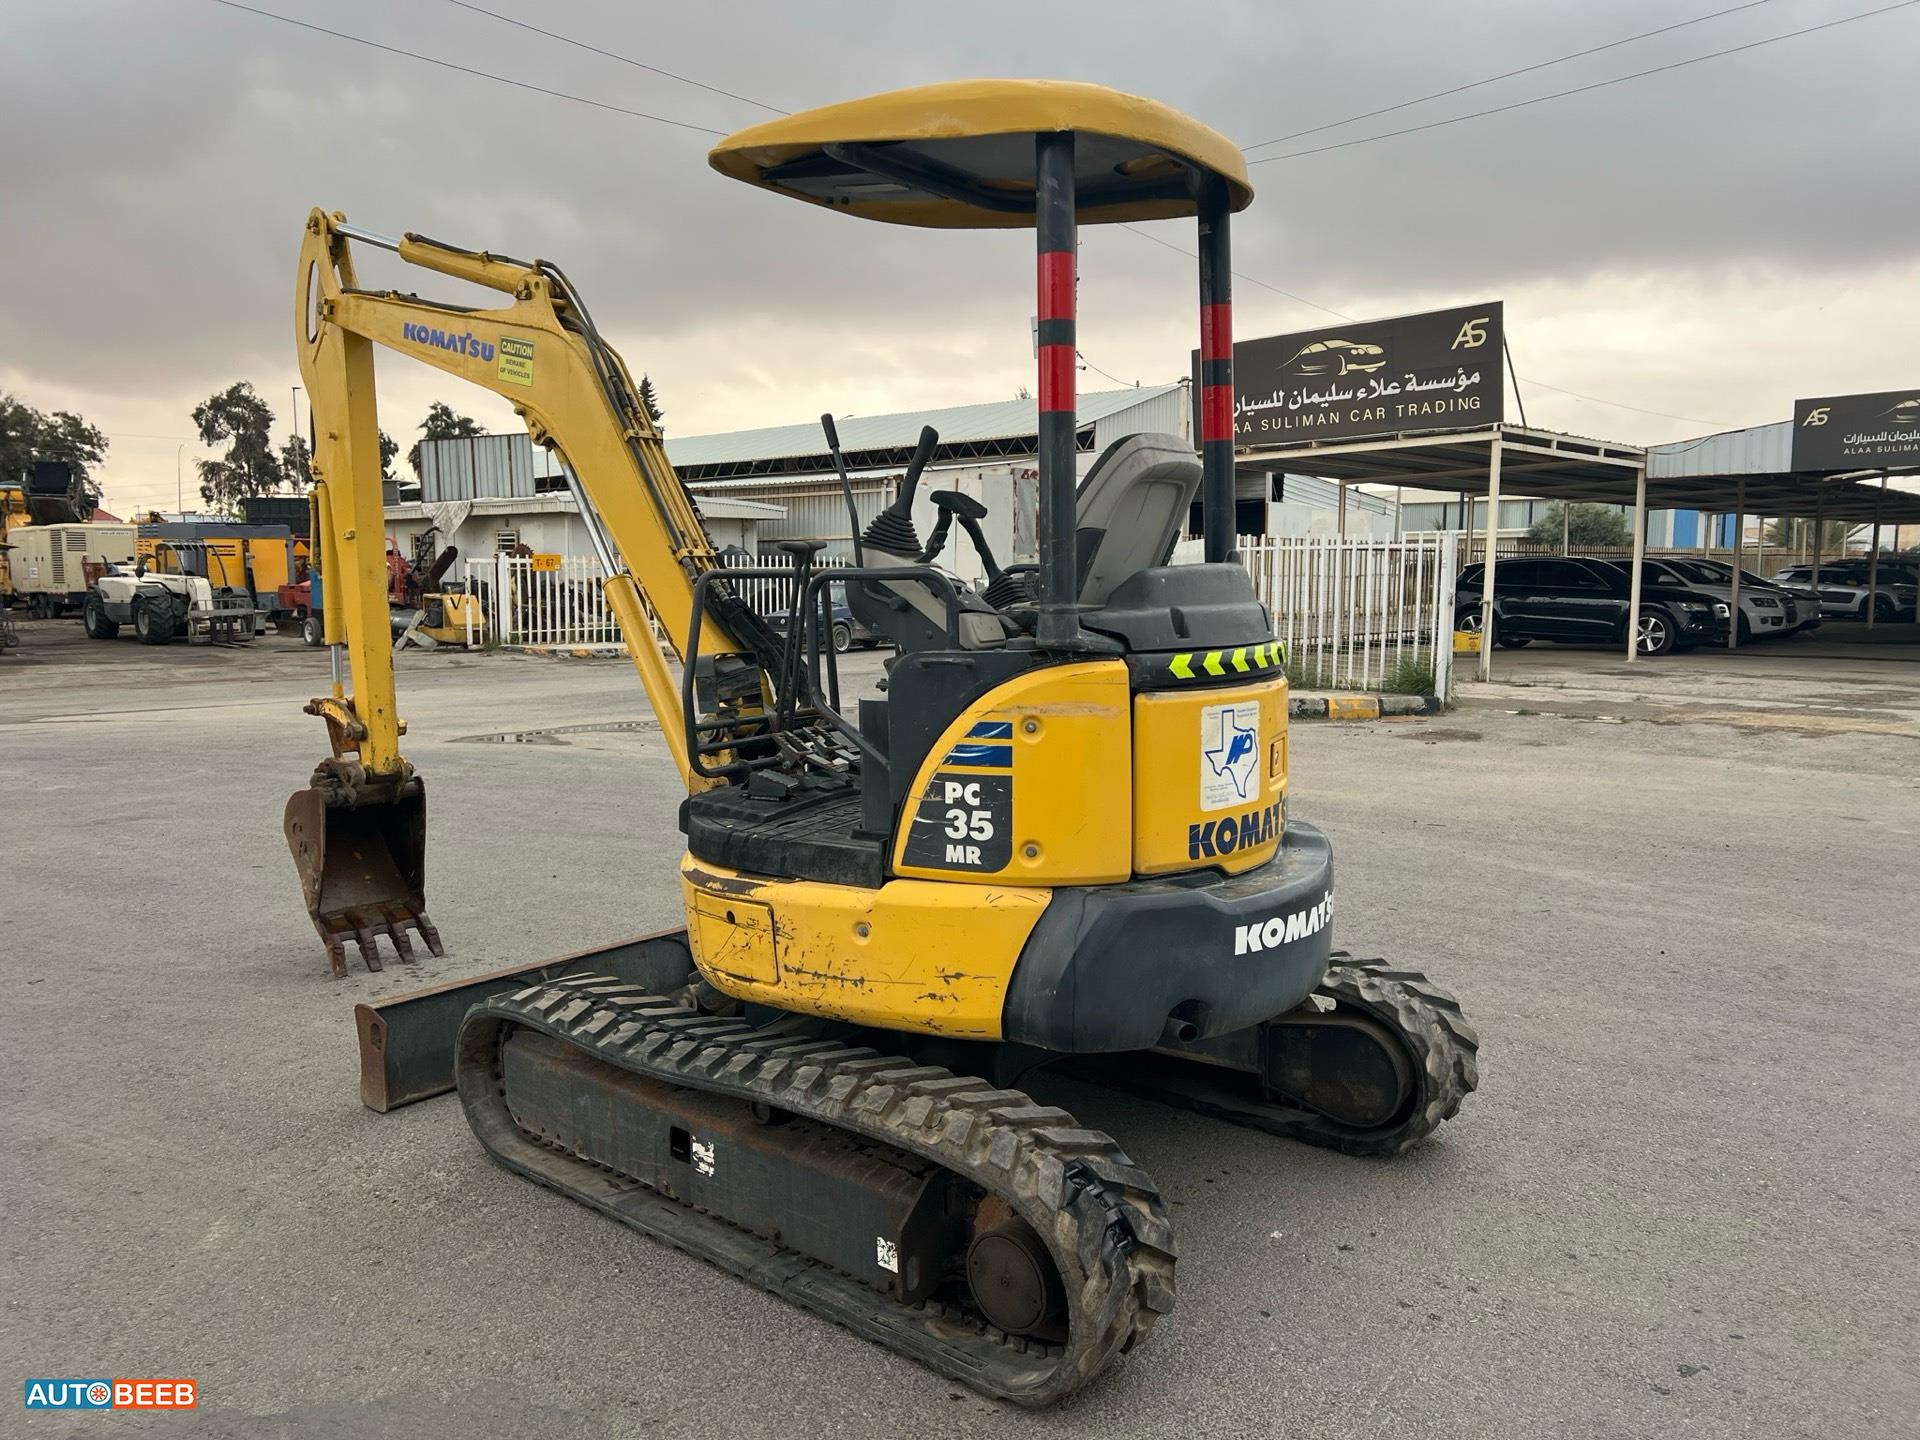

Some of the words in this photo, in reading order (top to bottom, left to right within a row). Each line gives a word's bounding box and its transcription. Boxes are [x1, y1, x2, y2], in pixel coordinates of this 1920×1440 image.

[403, 322, 494, 362] KOMATSU
[501, 341, 533, 358] CAUTION
[505, 359, 526, 368] BEWARE
[1356, 378, 1401, 401] علاء
[1404, 368, 1480, 393] مؤسسة
[1233, 390, 1285, 417] للسيار
[1288, 384, 1353, 409] سليمان
[1261, 412, 1340, 431] SULIMAN
[1350, 407, 1386, 422] CAR
[1396, 396, 1480, 418] TRADING
[1843, 431, 1887, 445] للسيارات
[1843, 446, 1872, 455] ALAA
[944, 781, 981, 806] PC
[944, 808, 995, 841] 35
[945, 844, 982, 865] MR
